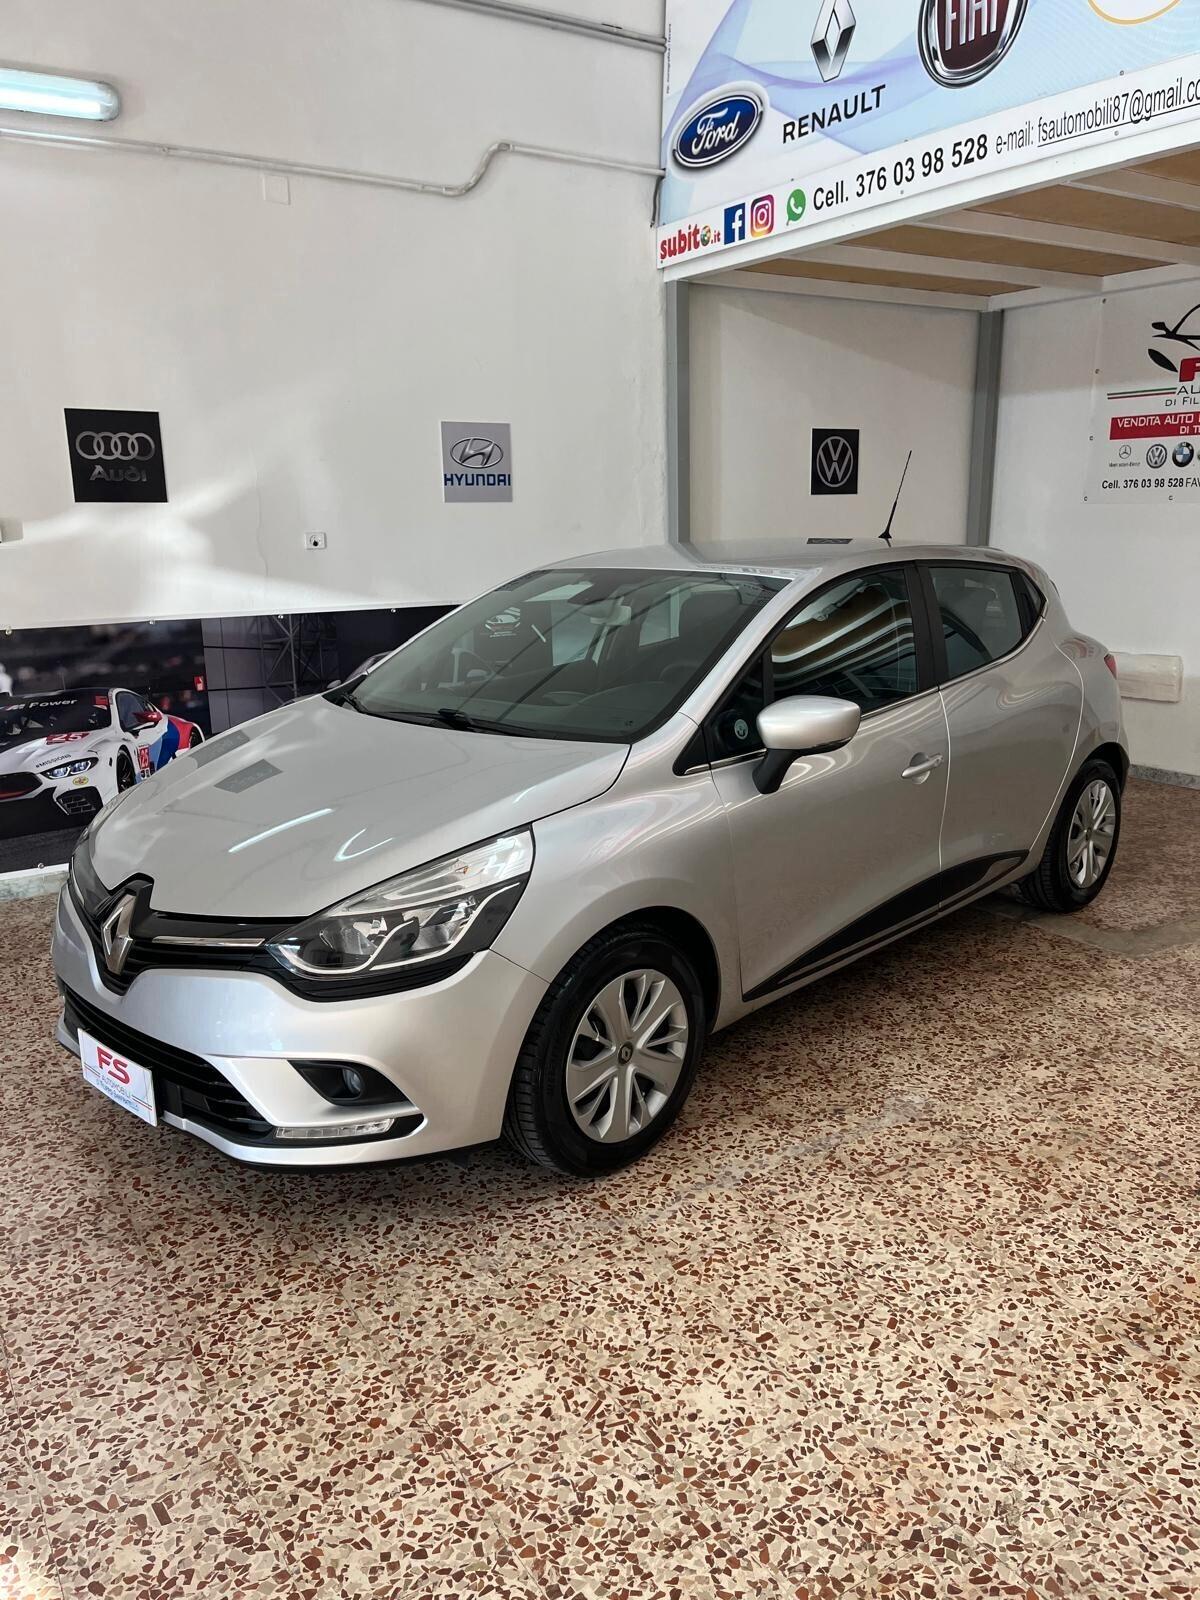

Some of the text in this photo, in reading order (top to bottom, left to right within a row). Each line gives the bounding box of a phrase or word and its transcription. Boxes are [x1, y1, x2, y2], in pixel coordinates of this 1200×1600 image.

[782, 84, 886, 144] RENAULT
[691, 107, 741, 155] Ford
[813, 179, 849, 211] Cell.
[856, 166, 887, 198] 376
[893, 157, 915, 186] 03
[922, 147, 944, 177] 98
[951, 133, 988, 168] 528
[995, 119, 1034, 154] e-mail:
[1165, 399, 1177, 407] DI
[1117, 415, 1161, 428] VENDITA
[1164, 413, 1194, 425] AUTO
[1180, 426, 1190, 434] DI
[89, 464, 148, 482] Audi
[444, 473, 511, 487] HYUNDAI
[1101, 480, 1121, 489] Cell.
[1123, 480, 1139, 489] 376
[1141, 479, 1152, 488] 03
[1154, 478, 1165, 488] 98
[1167, 478, 1184, 488] 528
[29, 699, 78, 709] Power
[50, 732, 86, 742] 25
[97, 1046, 131, 1085] FS
